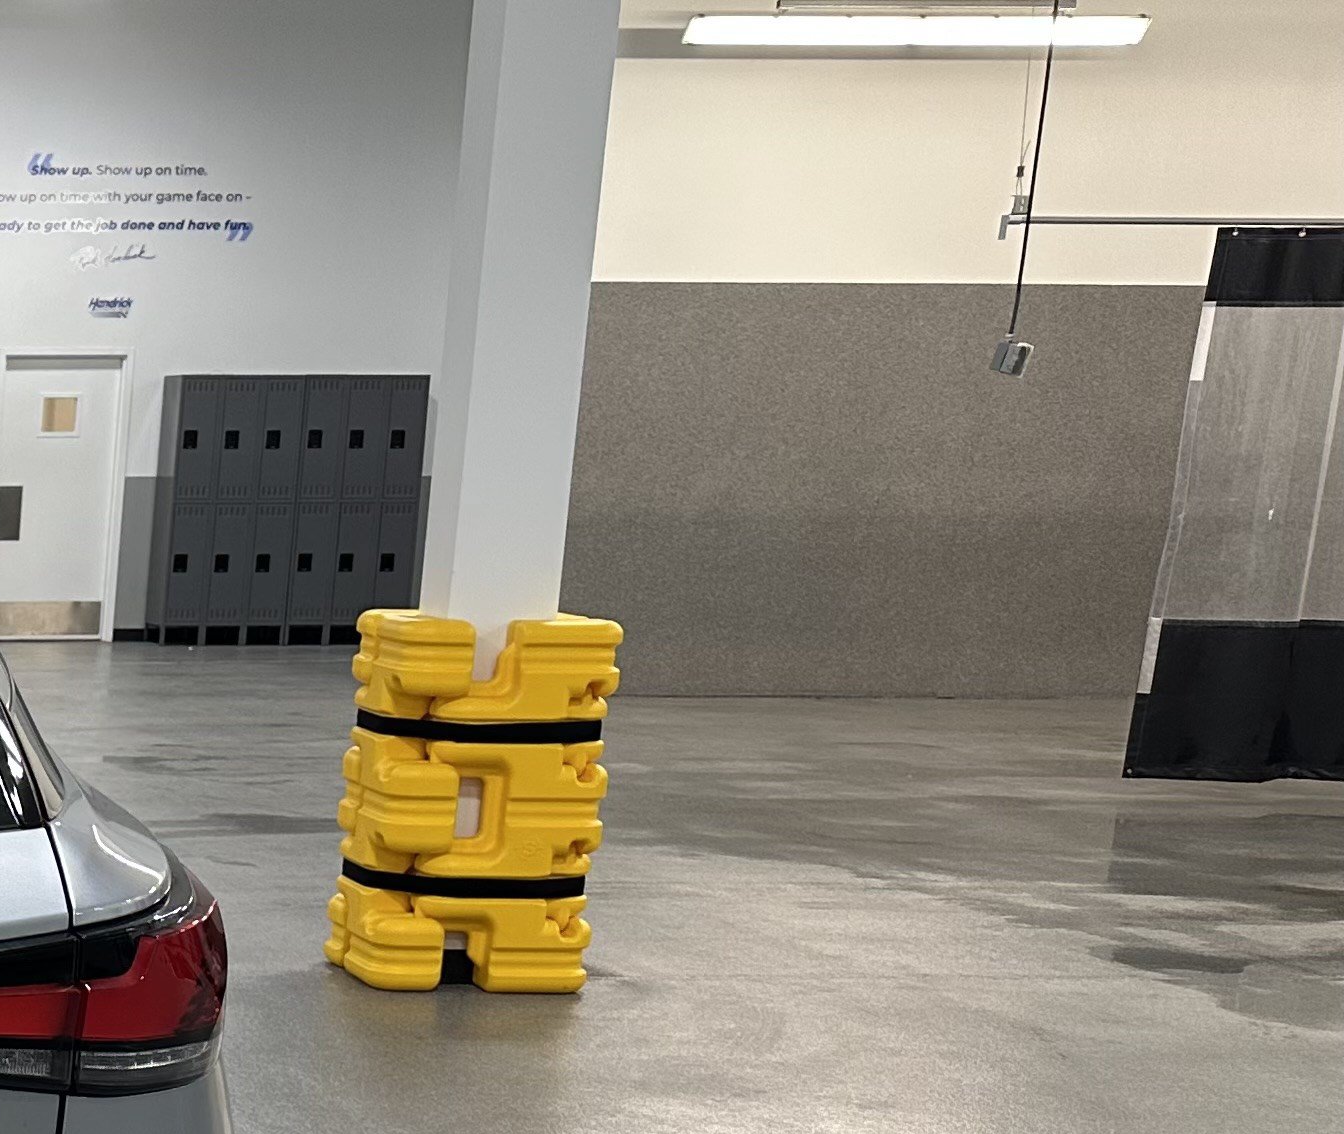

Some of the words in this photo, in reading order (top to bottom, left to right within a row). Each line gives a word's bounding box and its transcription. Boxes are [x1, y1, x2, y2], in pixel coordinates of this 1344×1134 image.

[72, 166, 93, 178] up.
[96, 164, 132, 176] Show
[135, 166, 153, 178] up
[155, 166, 172, 176] on
[175, 163, 208, 176] time.
[20, 193, 37, 204] up
[40, 193, 56, 202] on
[60, 191, 90, 202] time
[93, 191, 121, 202] with
[124, 193, 153, 204] your
[156, 193, 193, 205] game
[196, 190, 224, 202] face
[226, 193, 243, 202] on
[27, 220, 40, 230] to
[44, 220, 67, 233] get
[70, 219, 93, 230] the
[95, 219, 118, 232] job
[120, 220, 155, 230] done
[158, 219, 185, 230] and
[187, 219, 221, 230] have
